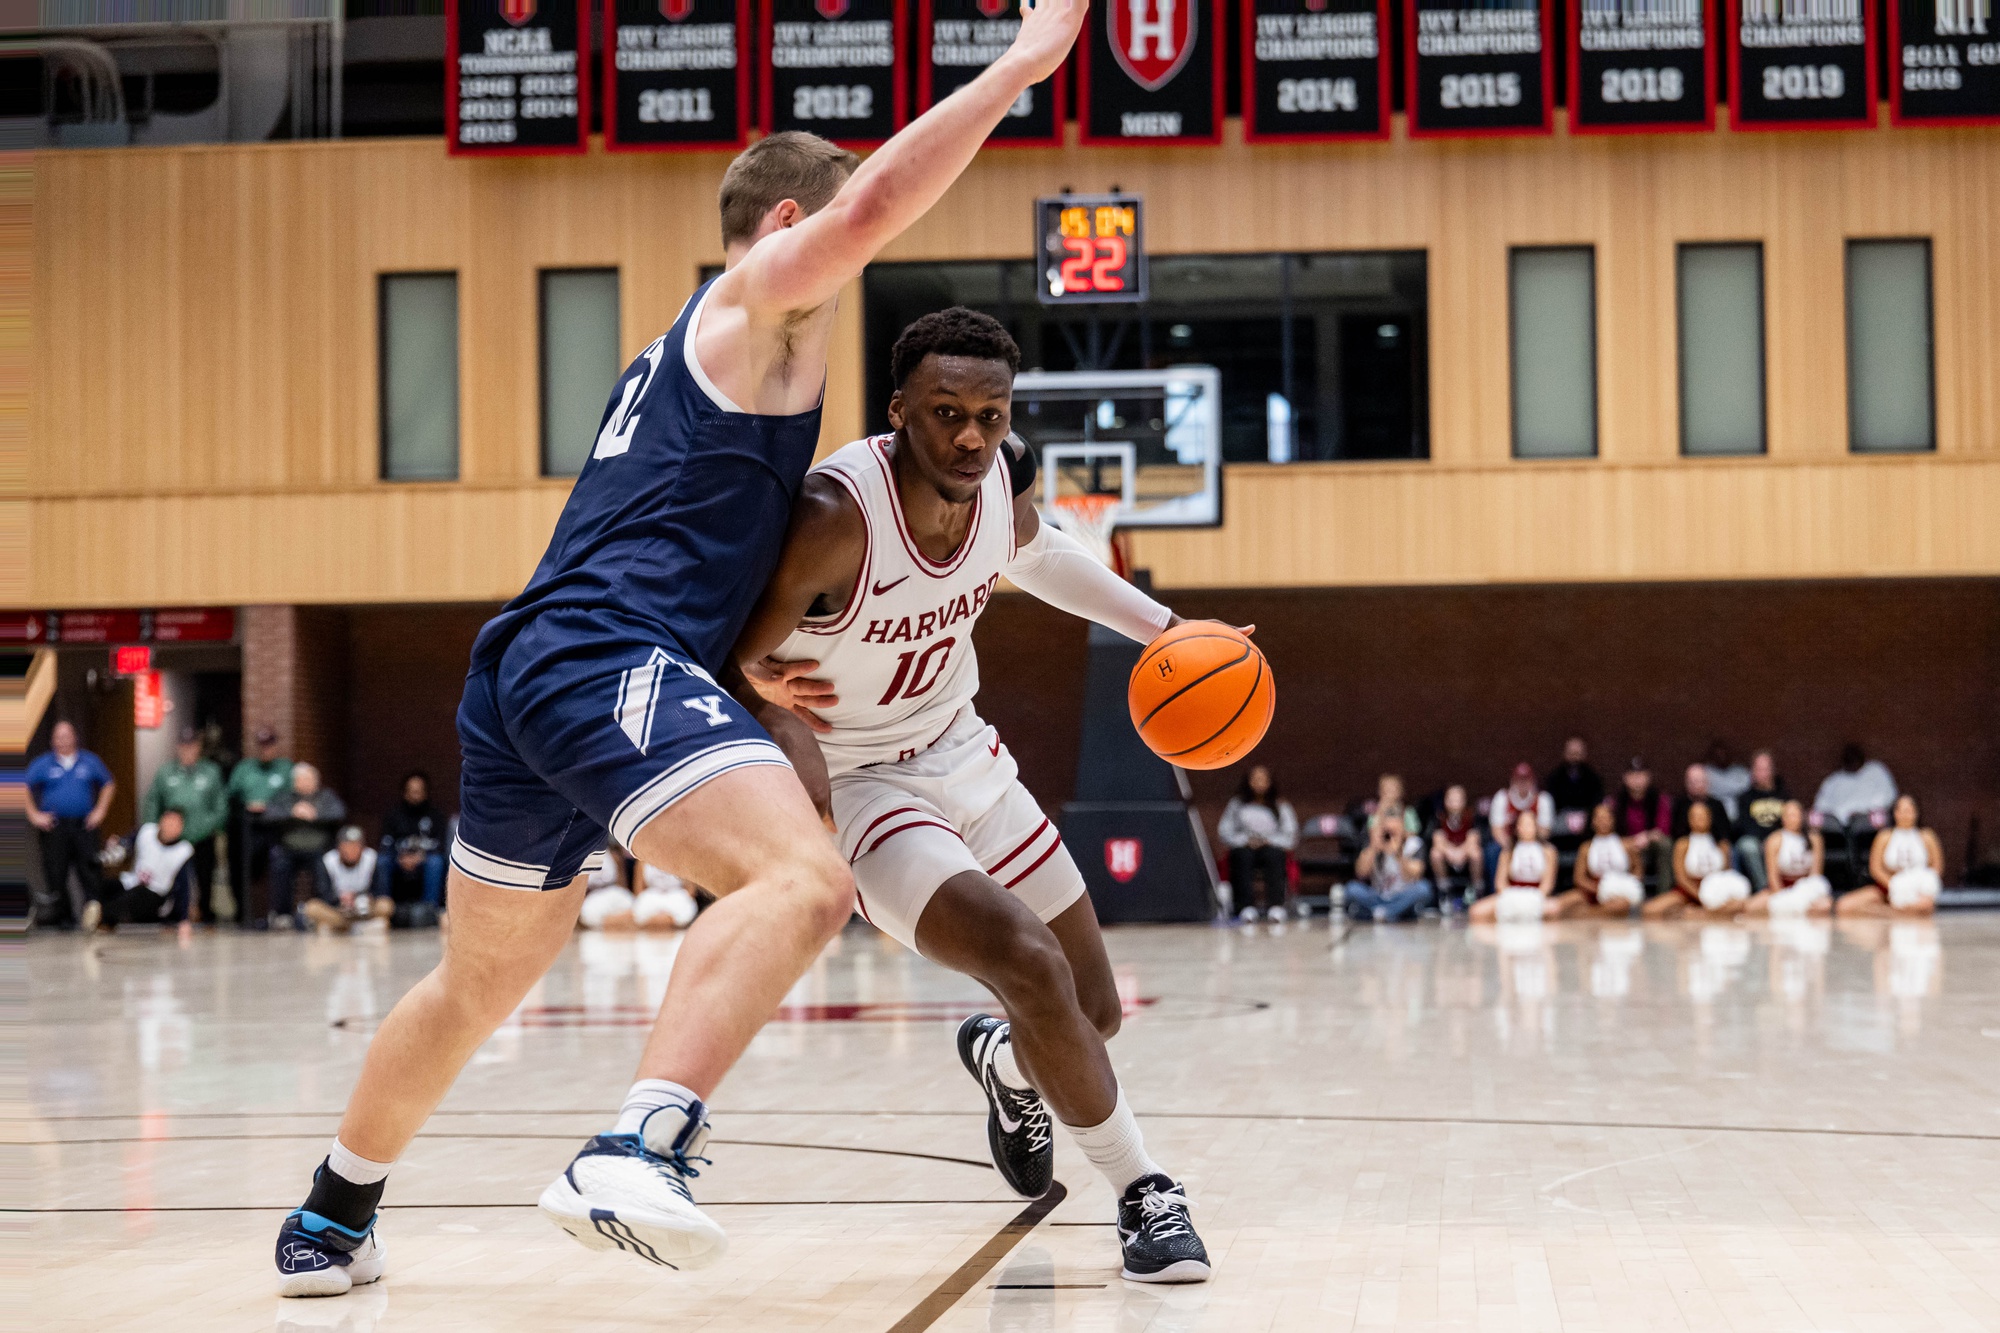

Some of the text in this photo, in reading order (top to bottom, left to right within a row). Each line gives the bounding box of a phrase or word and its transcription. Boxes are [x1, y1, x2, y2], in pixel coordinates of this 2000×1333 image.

[774, 20, 892, 46] IVY LEAGUE
[934, 20, 1022, 44] IVY LEA
[1128, 0, 1177, 60] H
[1257, 12, 1376, 39] IVY LEAGUE
[1418, 8, 1539, 34] IVY LEAGUE
[484, 27, 552, 55] NCAA
[617, 22, 736, 49] IVY LEAGUE
[1417, 33, 1541, 56] CHAMPIONS
[1580, 28, 1704, 51] CHAMPIONS
[1740, 24, 1864, 48] CHAMPIONS
[615, 48, 737, 71] CHAMPIONS
[772, 45, 894, 68] CHAMPIONS
[932, 43, 1010, 66] CHAMP
[1255, 37, 1378, 61] CHAMPIONS
[1902, 44, 1960, 67] 2011
[459, 51, 577, 75] TOURNAMENT
[1277, 77, 1358, 113] 2014
[1440, 72, 1521, 109] 2015
[1601, 67, 1683, 102] 2018
[1763, 64, 1845, 100] 2019
[638, 88, 714, 122] 2011
[793, 84, 873, 119] 2012
[1121, 112, 1182, 137] MEN
[1060, 236, 1127, 292] 22
[861, 572, 999, 644] HARVARD
[877, 636, 956, 706] 10
[1158, 658, 1173, 678] H
[682, 695, 733, 727] Y
